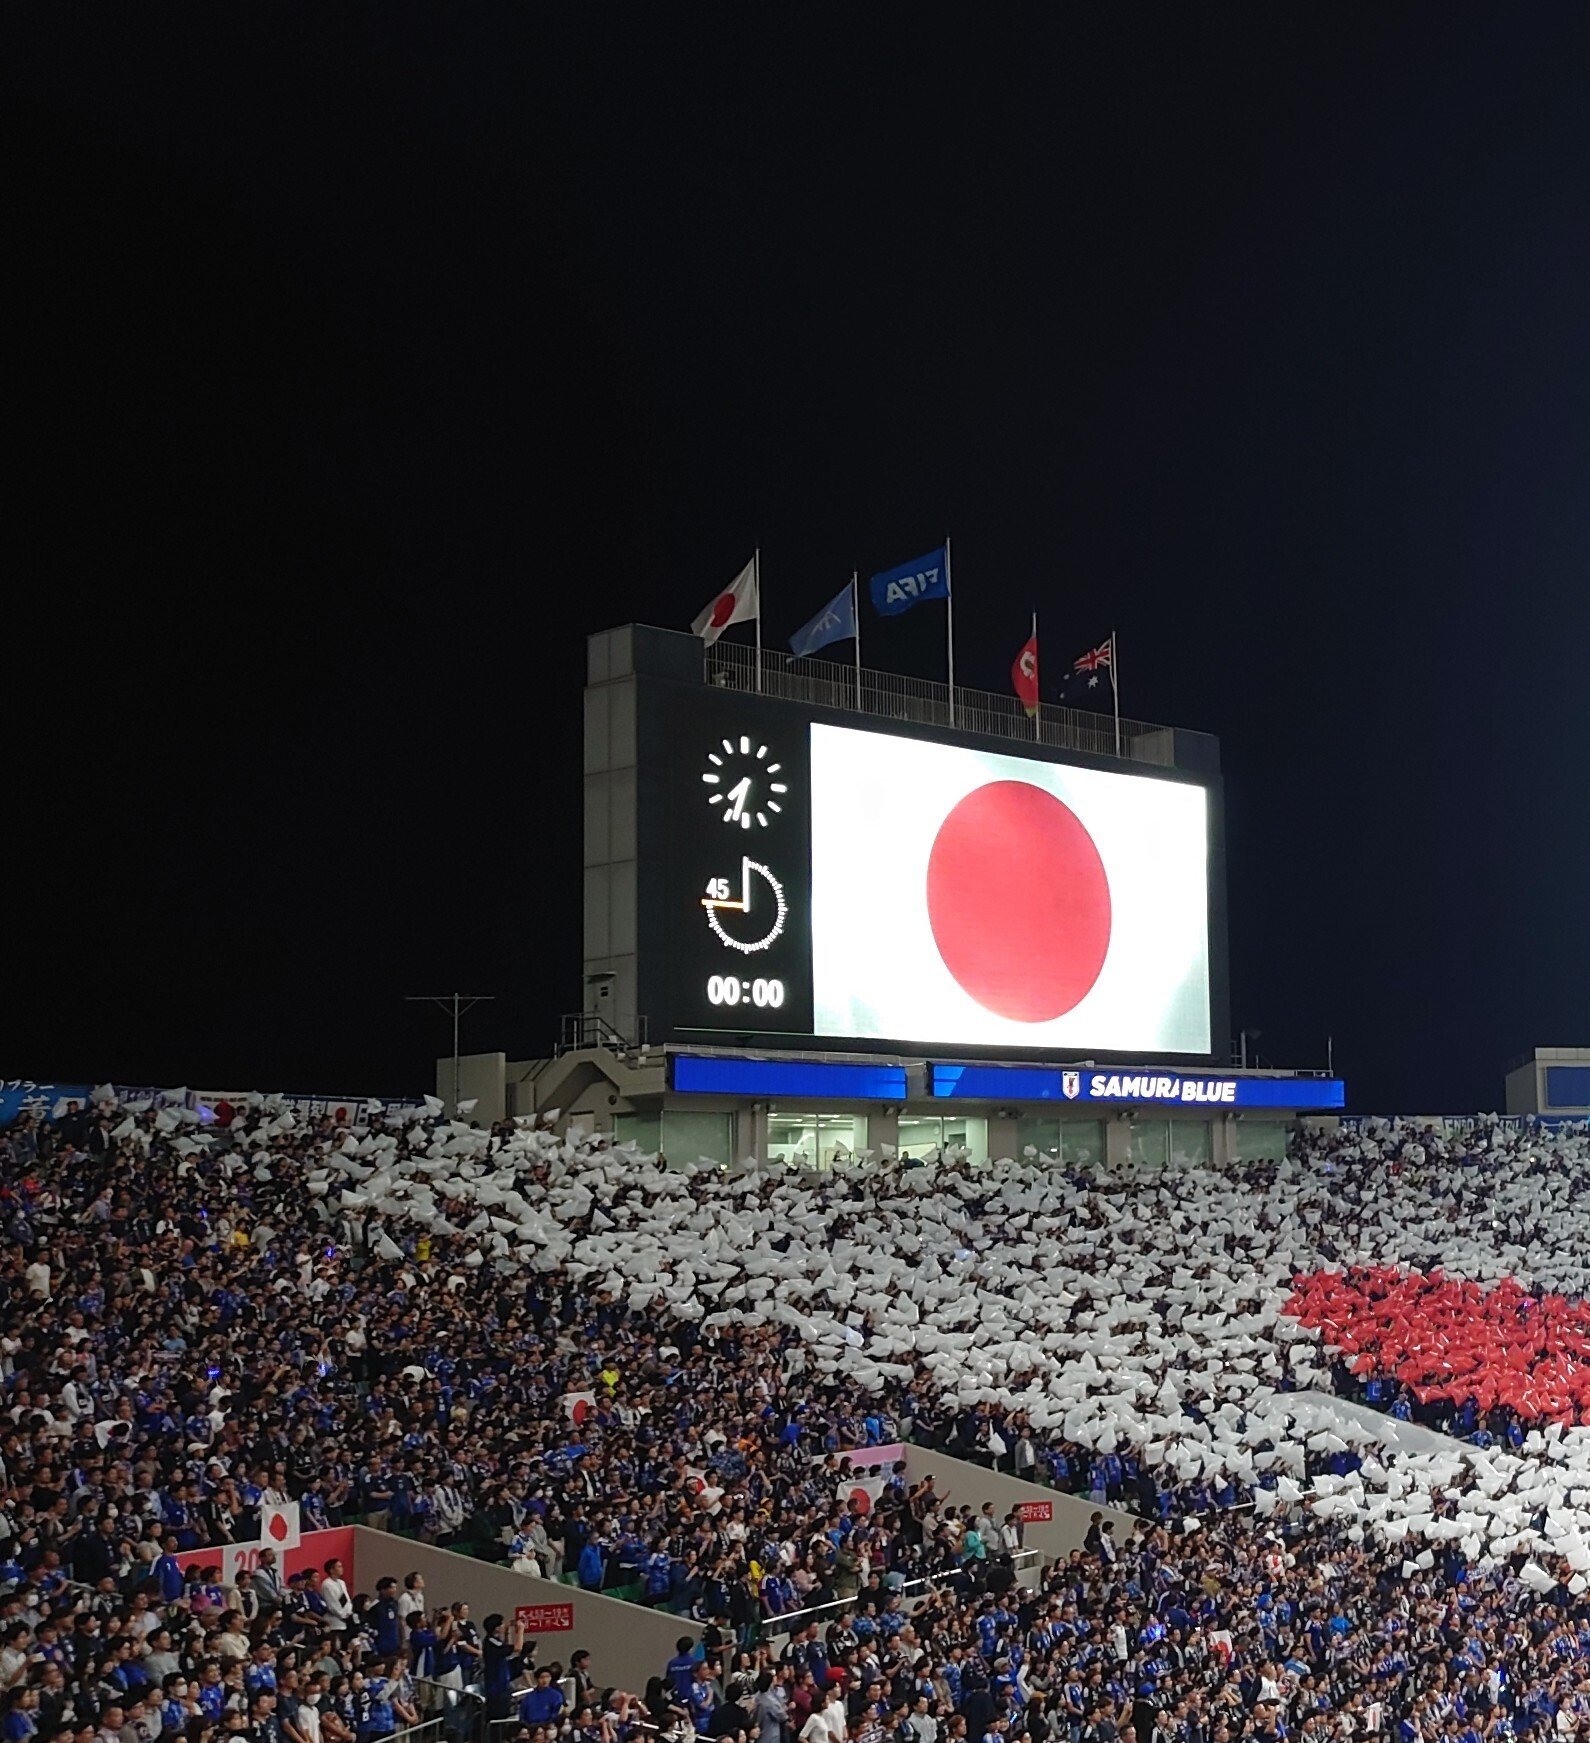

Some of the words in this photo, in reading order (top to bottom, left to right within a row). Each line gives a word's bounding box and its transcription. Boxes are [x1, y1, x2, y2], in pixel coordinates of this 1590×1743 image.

[706, 877, 730, 900] 45
[707, 975, 784, 1008] 00:00
[1090, 1075, 1180, 1098] SAMURA
[1181, 1081, 1237, 1102] BLUE
